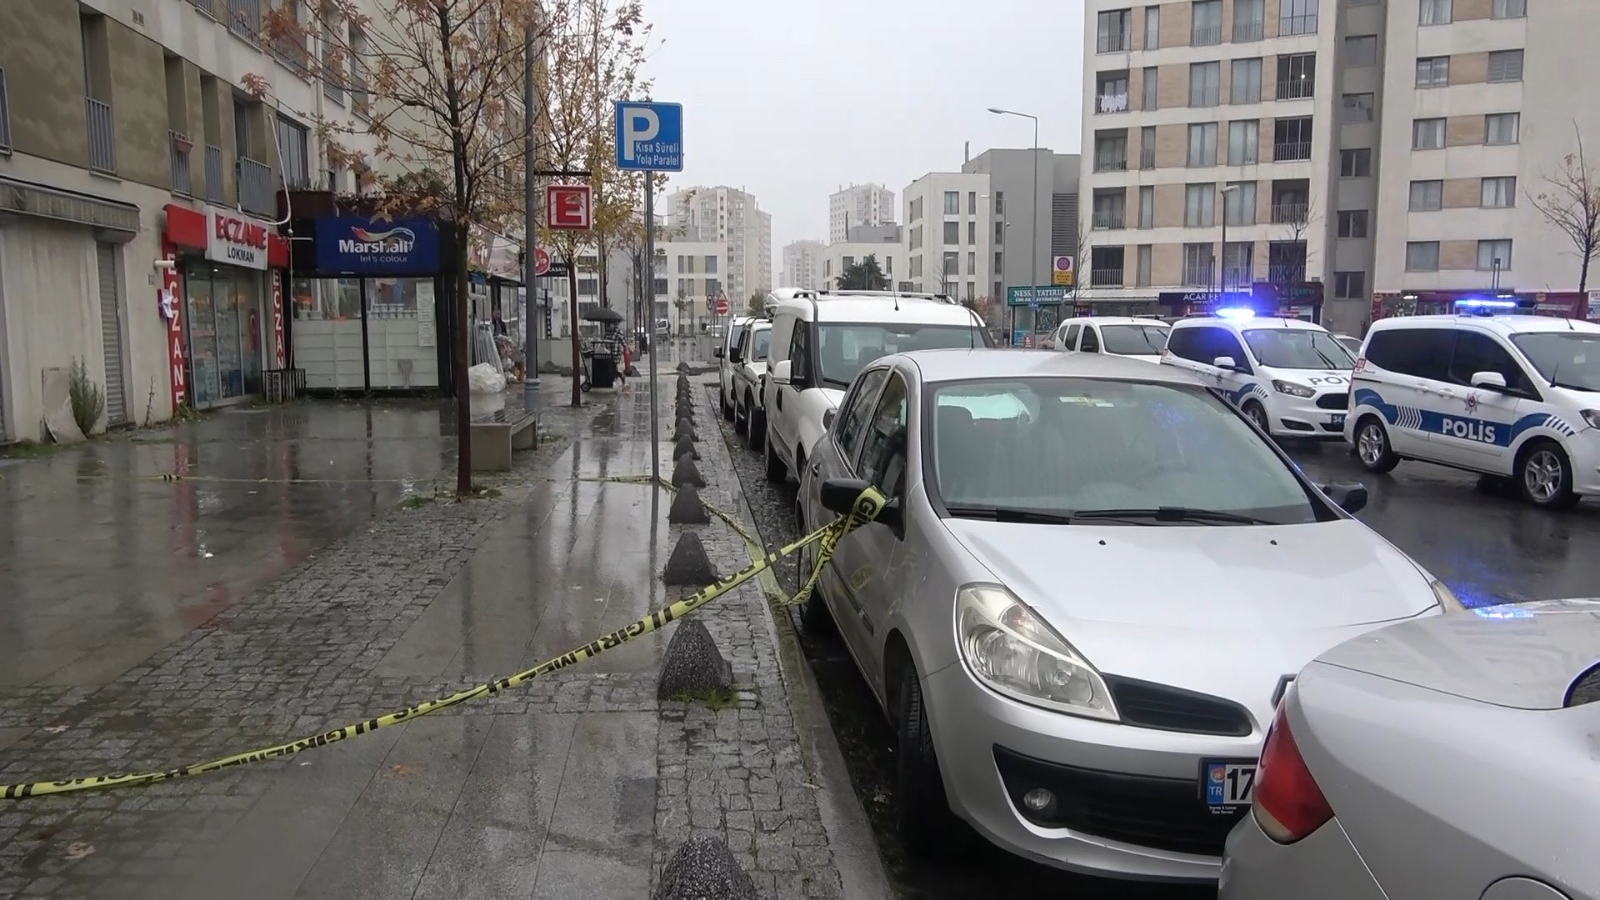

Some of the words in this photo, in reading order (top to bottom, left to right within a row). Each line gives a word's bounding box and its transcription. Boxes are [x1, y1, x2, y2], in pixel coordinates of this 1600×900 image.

[623, 107, 660, 161] P
[635, 142, 654, 152] Kısa
[655, 142, 679, 153] Süreli
[636, 154, 652, 166] Yola
[653, 154, 679, 166] Paralel
[556, 192, 582, 224] E
[215, 213, 267, 250] ECZANE
[227, 245, 255, 263] LOKMAN
[338, 239, 408, 253] Marshall
[379, 255, 408, 263] colour
[1183, 293, 1207, 301] ACAR
[1442, 418, 1496, 443] POLİS
[1209, 786, 1223, 796] TR
[1226, 768, 1257, 801] 17
